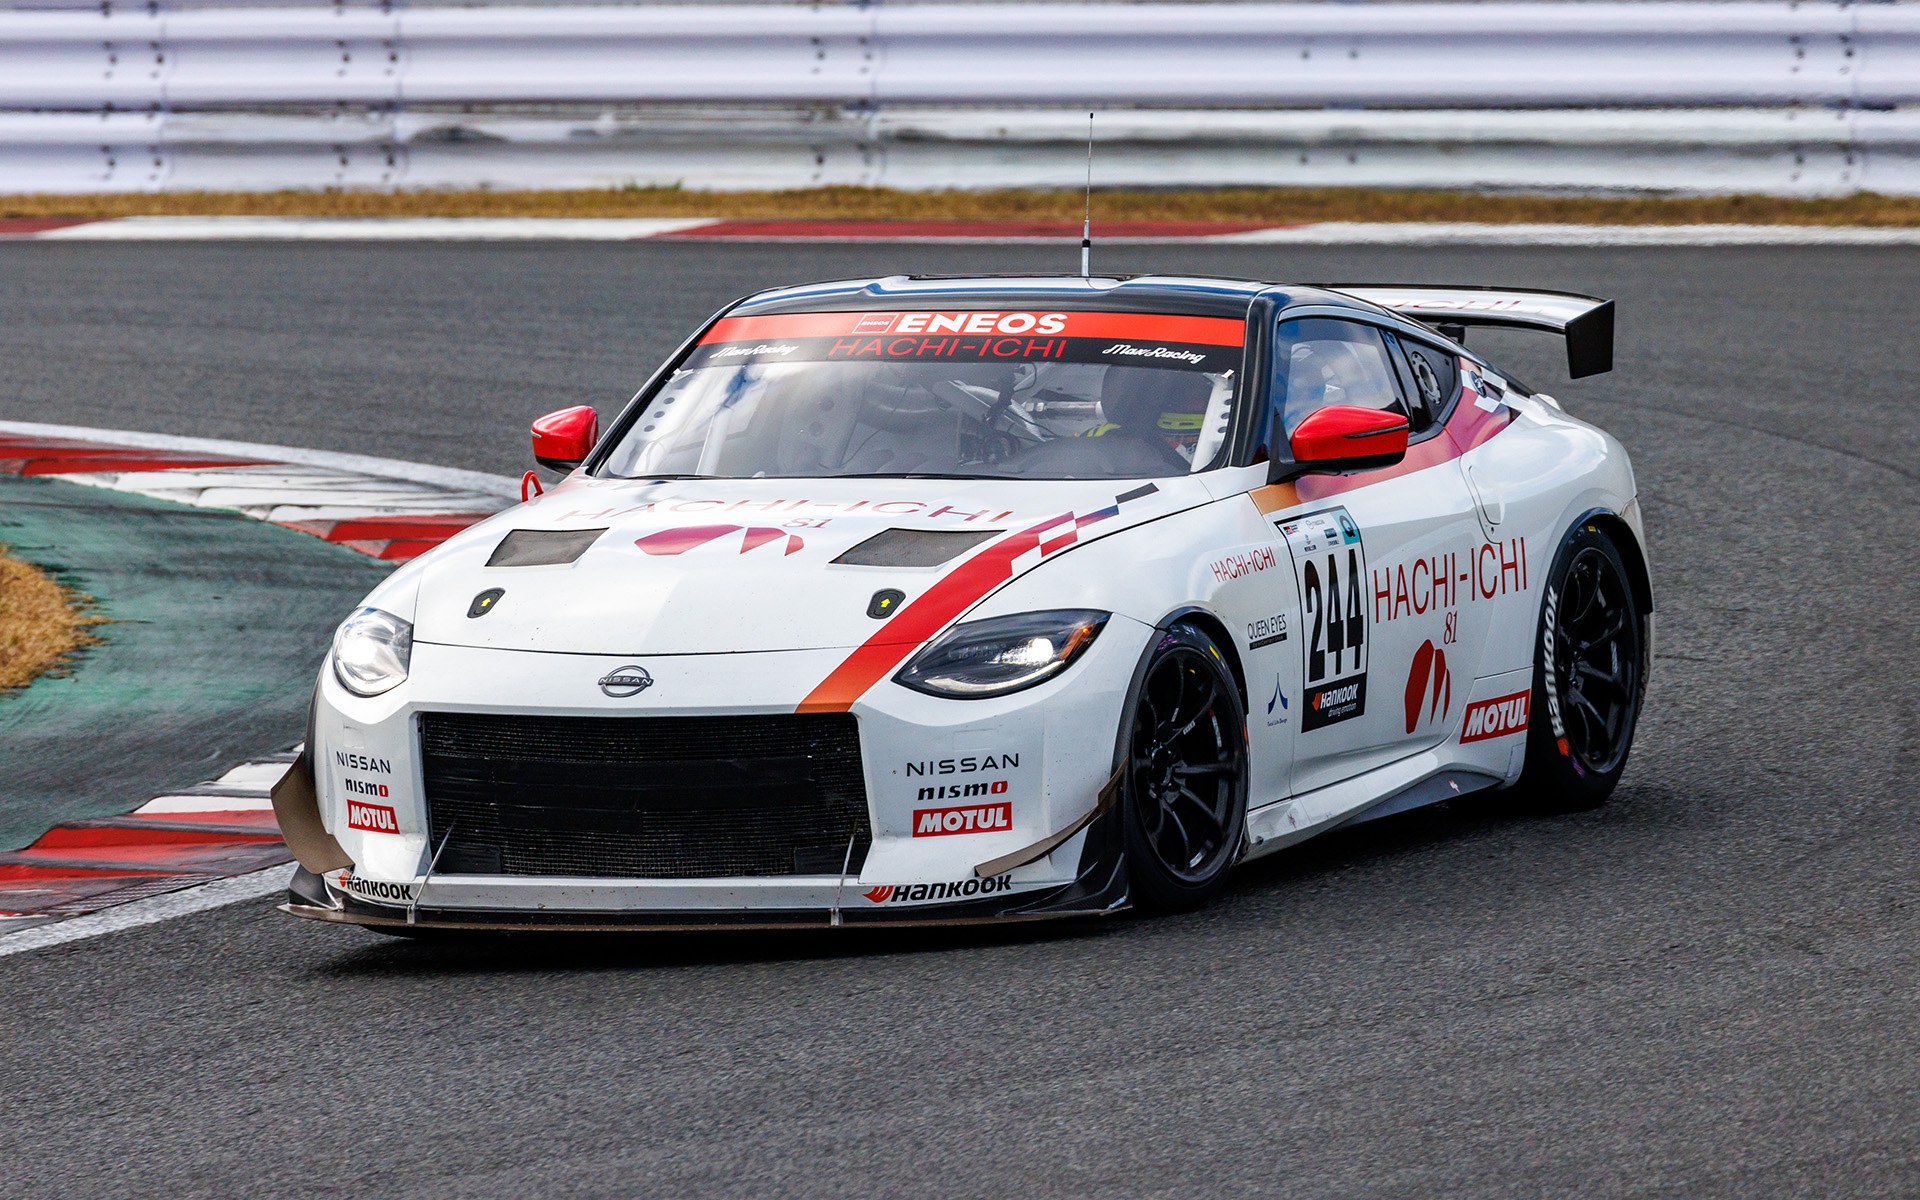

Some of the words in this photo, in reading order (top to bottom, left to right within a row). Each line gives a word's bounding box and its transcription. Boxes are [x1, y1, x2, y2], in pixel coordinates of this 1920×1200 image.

[894, 313, 1068, 335] ENEOS
[828, 337, 1067, 358] HACHI-ICHI
[554, 499, 1013, 523] HACHI-ICHI
[781, 517, 833, 529] 81
[1210, 546, 1276, 583] HACHI-ICHI
[1373, 537, 1527, 624] HACHI-ICHI
[1247, 619, 1271, 640] QUEEN
[1271, 613, 1287, 634] EYES
[1304, 548, 1364, 683] 244
[1444, 610, 1458, 645] 81
[600, 677, 652, 685] NISSAN
[1465, 692, 1529, 738] MOTUL
[336, 751, 391, 774] NISSAN
[906, 753, 1019, 777] NISSAN
[350, 804, 395, 831] MOTUL
[917, 807, 1008, 833] MOTUL
